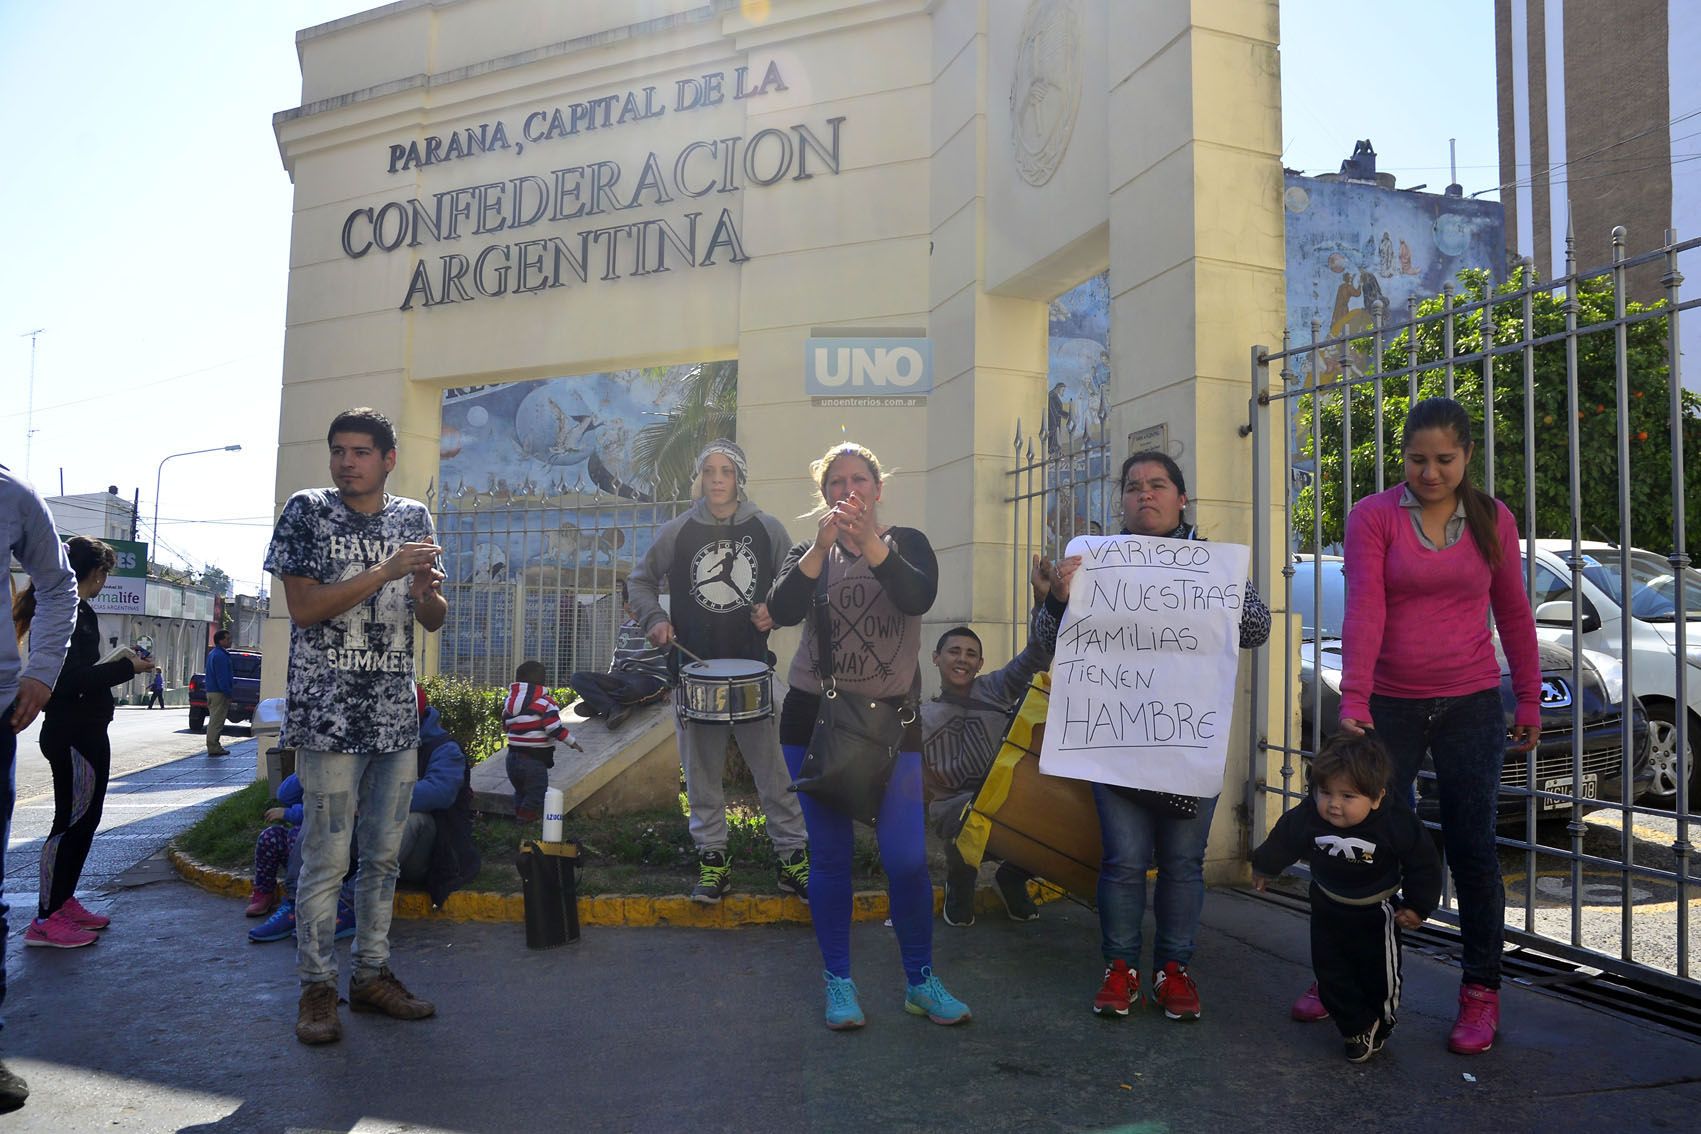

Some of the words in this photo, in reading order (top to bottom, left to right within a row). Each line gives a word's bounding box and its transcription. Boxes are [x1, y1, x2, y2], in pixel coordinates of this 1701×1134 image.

[523, 86, 666, 143] CAPITAL
[673, 69, 725, 113] DE
[733, 60, 789, 100] LA
[341, 116, 847, 259] CONFEDERACION
[400, 207, 751, 311] ARGENTINA
[115, 551, 136, 569] ES
[1085, 540, 1210, 567] VARISCO
[840, 584, 865, 609] GO
[1090, 579, 1240, 612] NUESTRAS
[864, 615, 900, 639] OWN
[1059, 614, 1197, 655] FAMILIAS
[832, 652, 869, 677] WAY
[1058, 658, 1155, 690] TIENEN
[1061, 697, 1217, 745] HAMBRE
